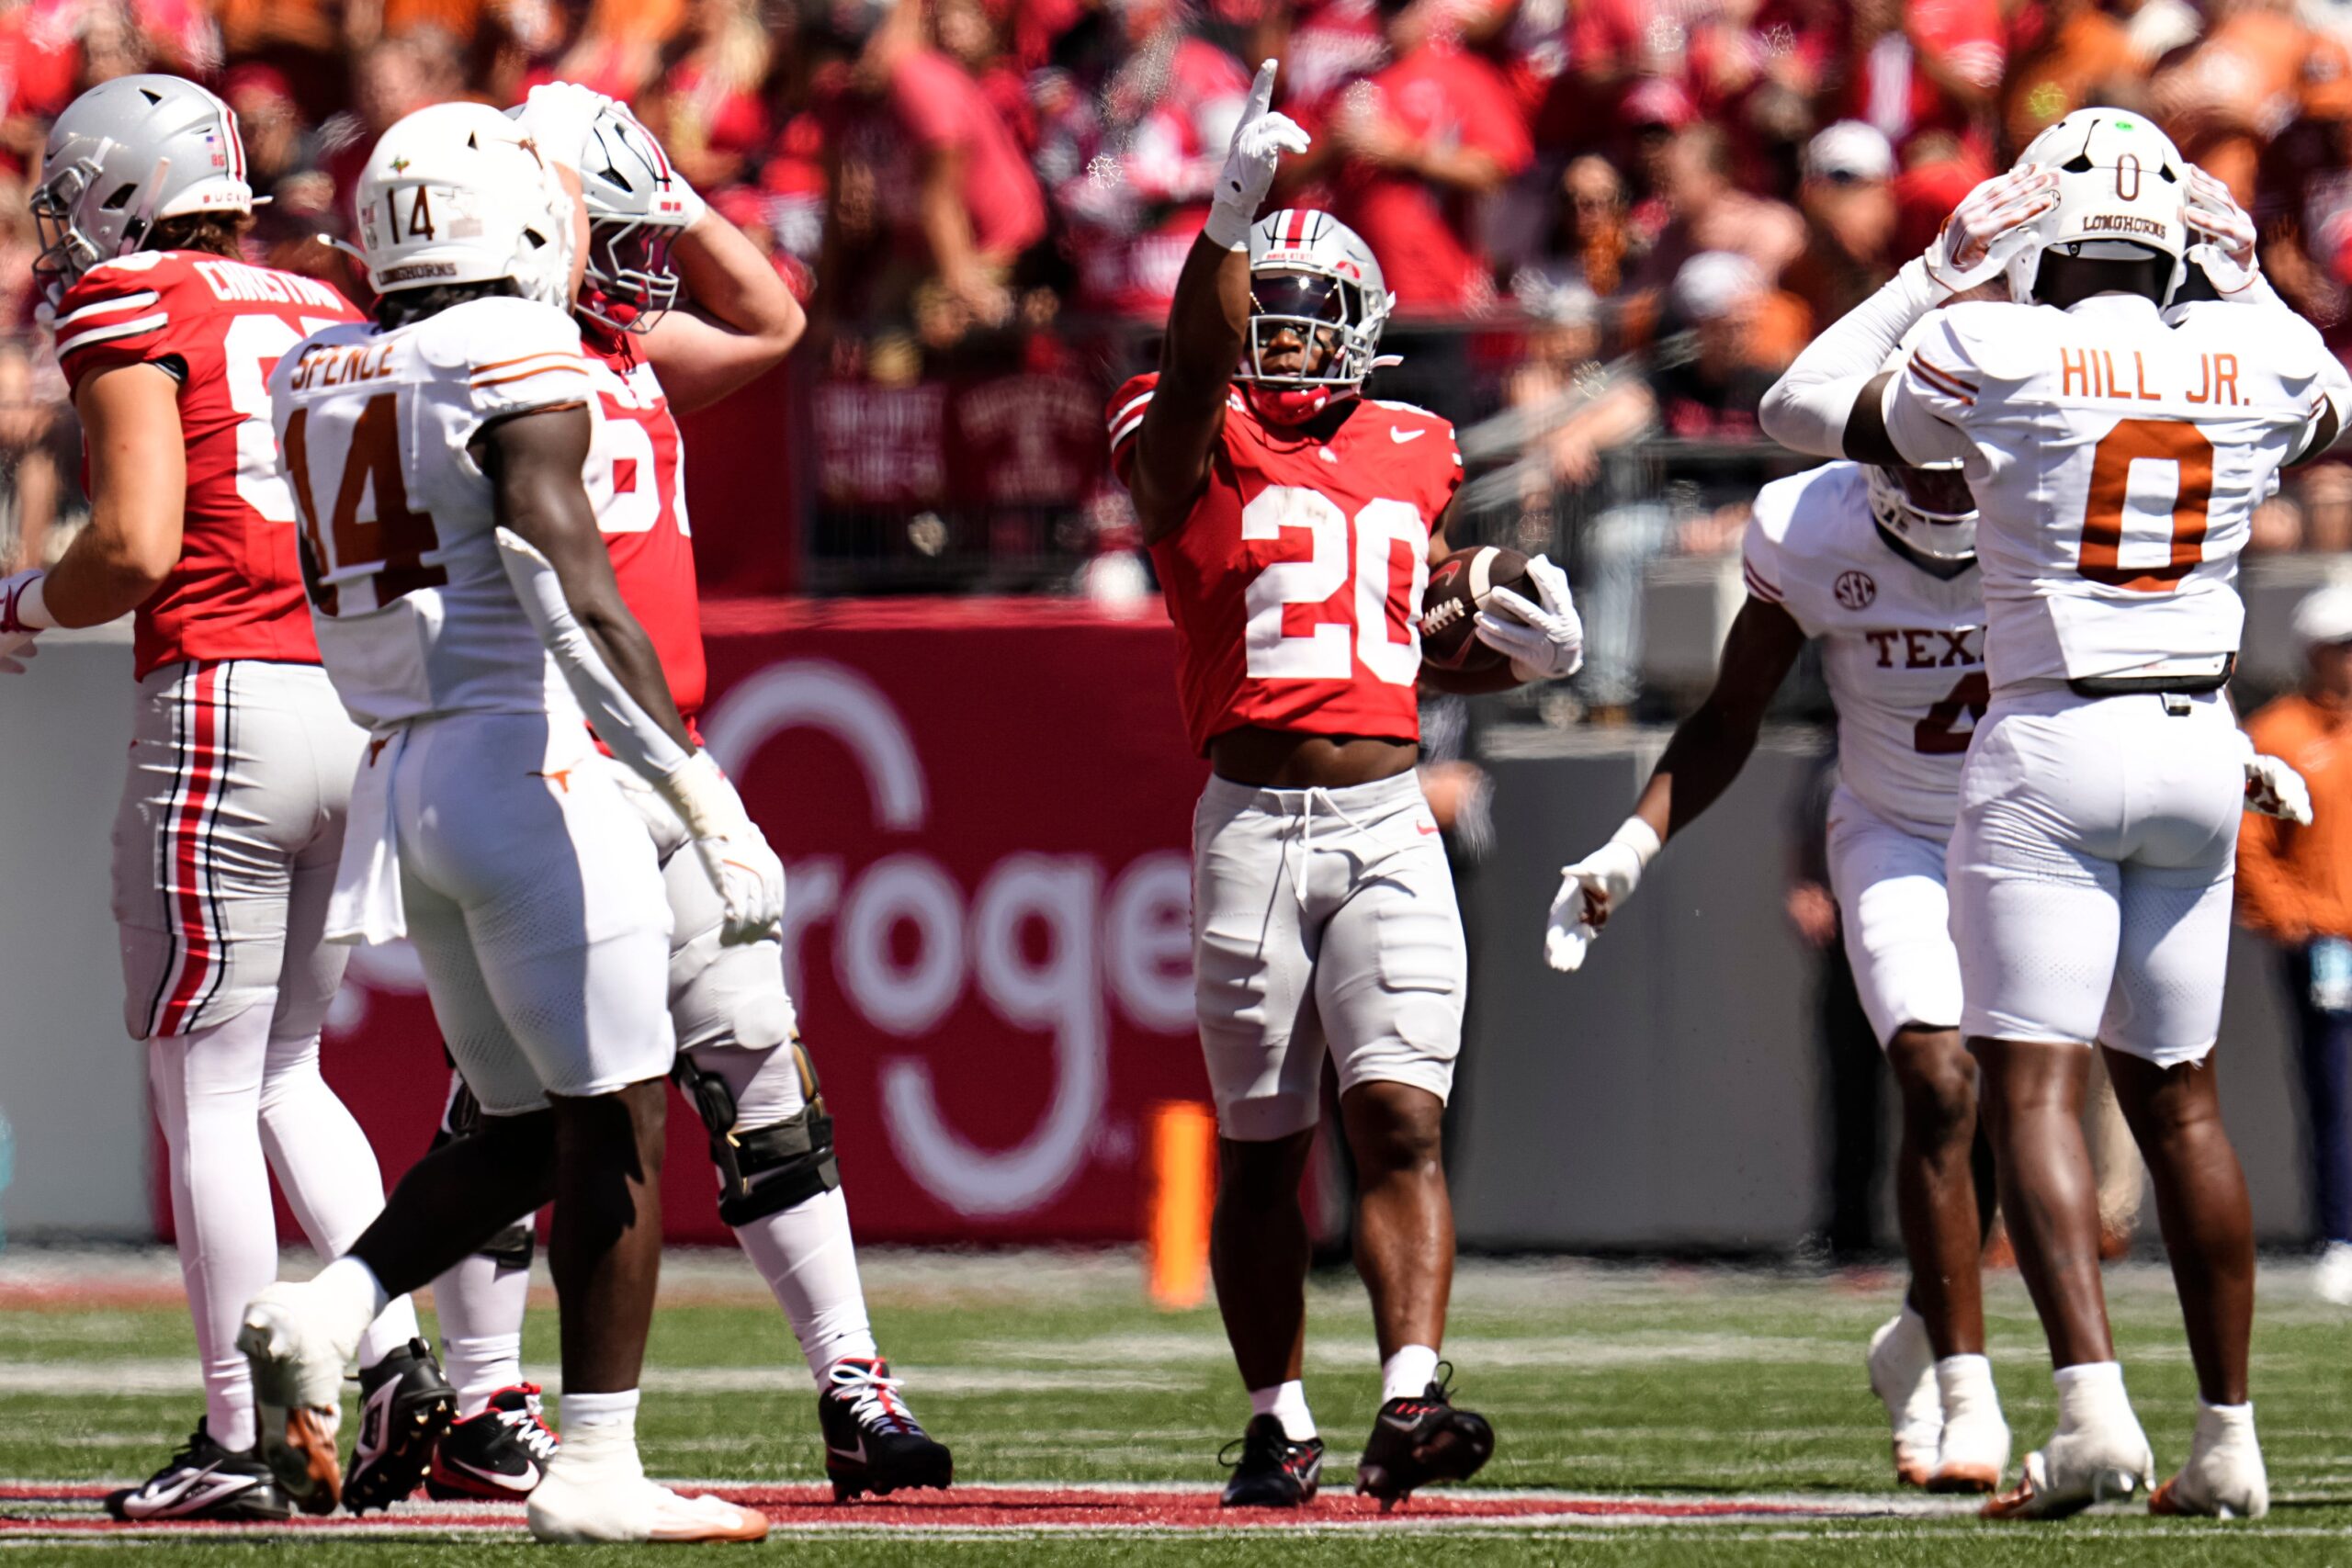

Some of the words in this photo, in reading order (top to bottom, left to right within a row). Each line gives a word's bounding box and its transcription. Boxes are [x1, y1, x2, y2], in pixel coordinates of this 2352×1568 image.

[386, 184, 435, 245] 14
[2082, 214, 2167, 241] LONGHORNS
[291, 343, 394, 390] SPENCE
[2060, 346, 2162, 401] HILL
[2185, 353, 2250, 407] JR.
[283, 391, 449, 618] 14
[2075, 418, 2214, 592] 0
[1241, 484, 1430, 687] 20
[1836, 570, 1876, 612] SEC
[1866, 625, 1988, 669] TEX
